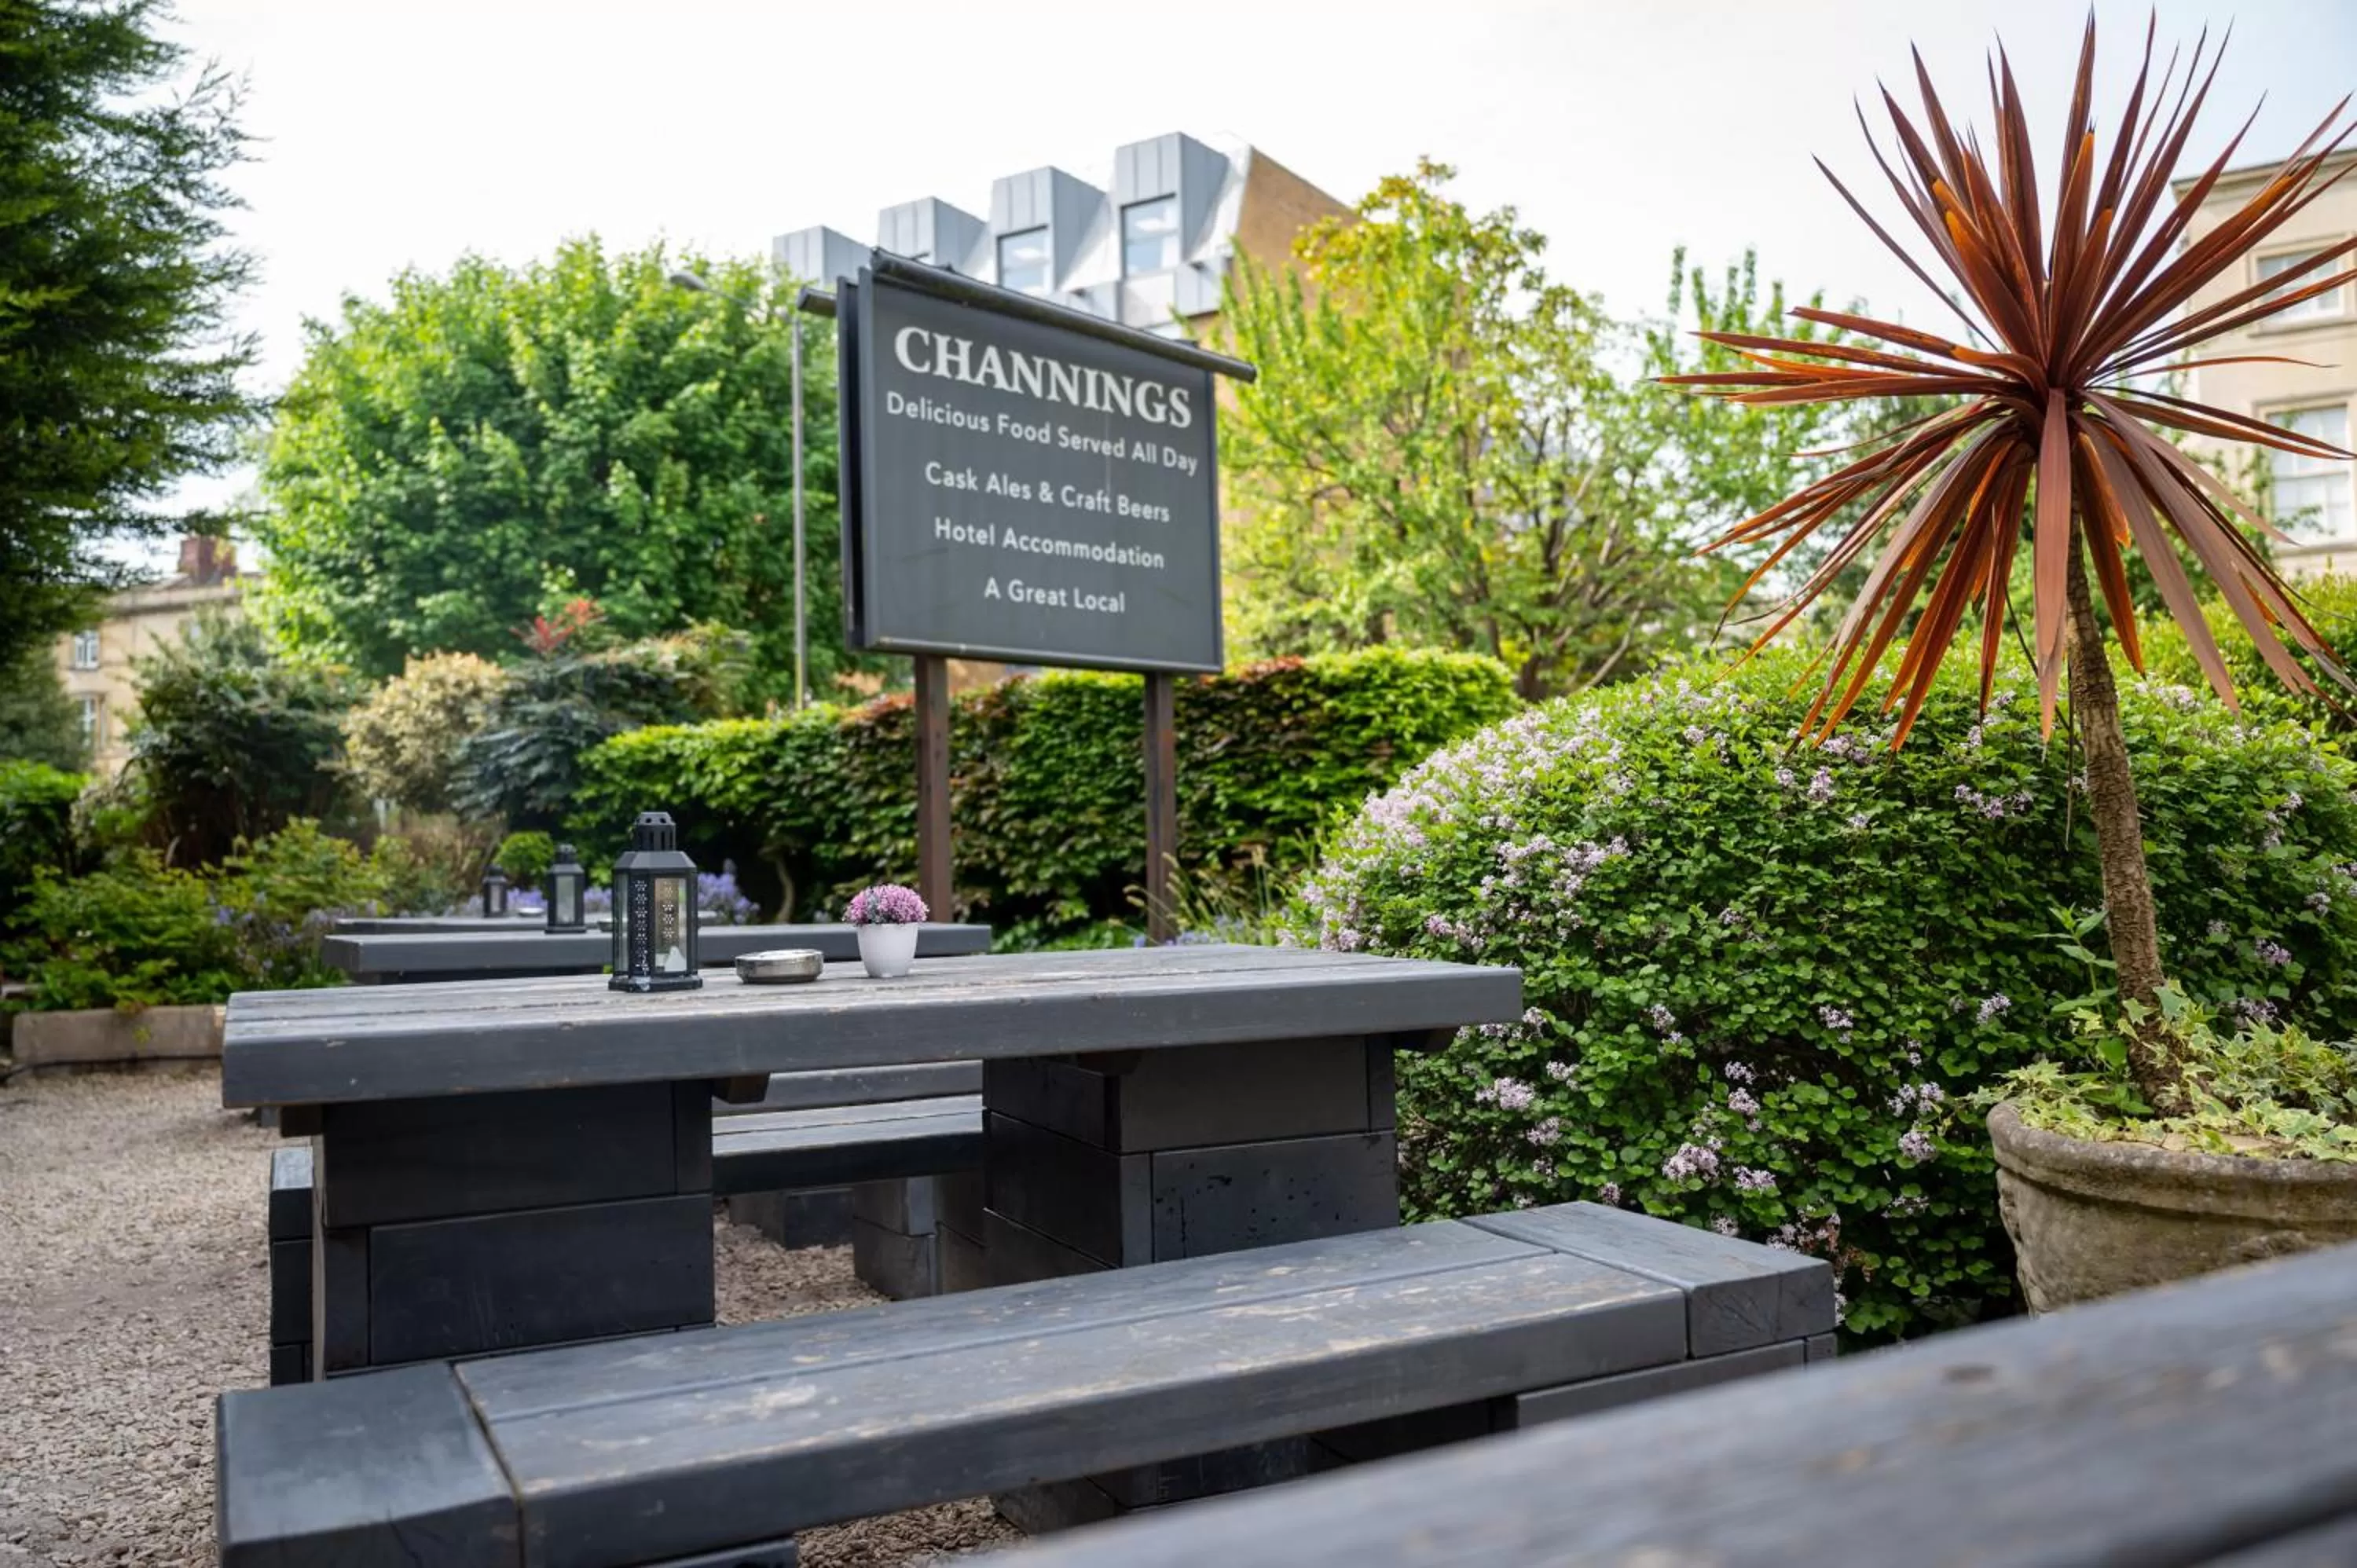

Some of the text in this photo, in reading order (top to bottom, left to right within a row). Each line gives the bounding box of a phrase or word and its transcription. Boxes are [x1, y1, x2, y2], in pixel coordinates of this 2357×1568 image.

[894, 326, 1192, 428] CHANNINGS
[886, 390, 1197, 477] Delicious Food Served All Day
[925, 461, 1170, 522] Cask Ales & Craft Beers
[934, 516, 1164, 569] Hotel Accommodation
[984, 577, 1125, 613] A Great Local
